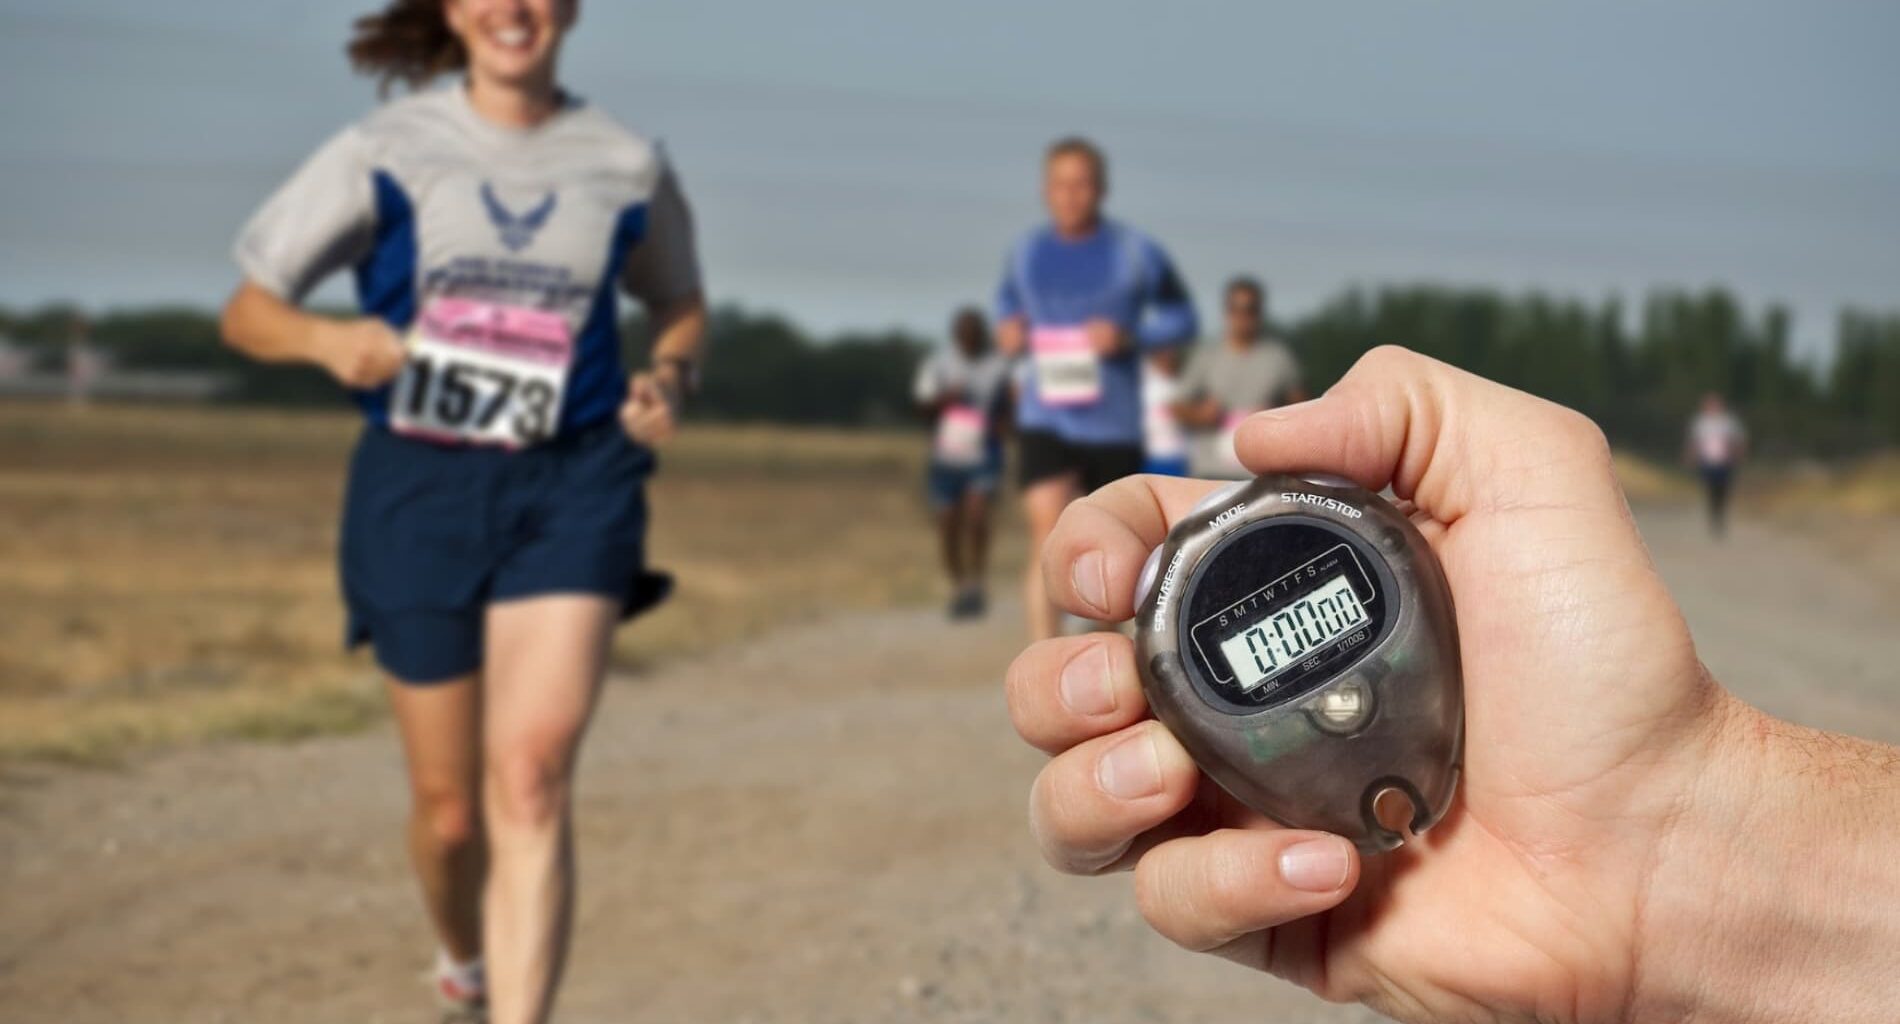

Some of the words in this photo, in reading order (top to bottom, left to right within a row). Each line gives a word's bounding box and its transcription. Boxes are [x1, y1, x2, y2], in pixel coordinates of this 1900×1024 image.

[406, 355, 556, 443] 1573
[1208, 502, 1246, 531] MODE
[1281, 492, 1362, 519] START/STOP
[1154, 549, 1184, 632] SPLIT/RESET
[1219, 615, 1229, 627] S
[1234, 605, 1247, 618] M
[1250, 597, 1259, 609] T
[1262, 588, 1276, 601] W
[1281, 581, 1289, 591] T
[1294, 573, 1303, 584] F
[1306, 566, 1316, 577] S
[1262, 679, 1280, 694] MIN
[1303, 656, 1321, 671] SEC
[1337, 630, 1366, 651] 1/100S
